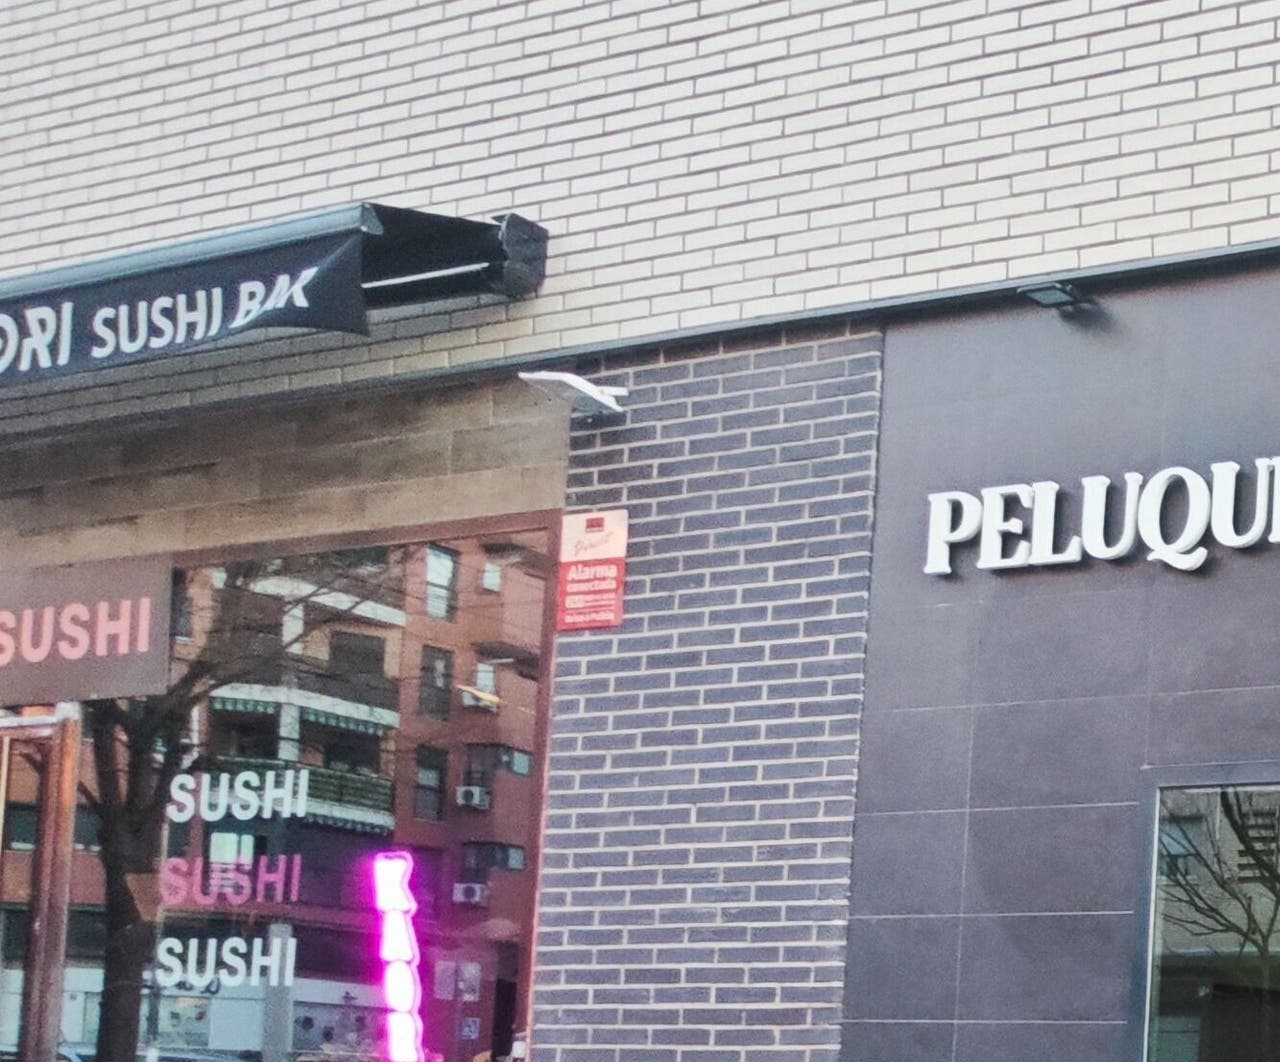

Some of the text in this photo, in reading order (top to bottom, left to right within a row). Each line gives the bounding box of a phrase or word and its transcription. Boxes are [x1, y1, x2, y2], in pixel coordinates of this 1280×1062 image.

[91, 287, 222, 359] SUSHI
[166, 769, 310, 823] SUSHI
[159, 854, 302, 905] SUSHI
[155, 936, 298, 988] SUSHI
